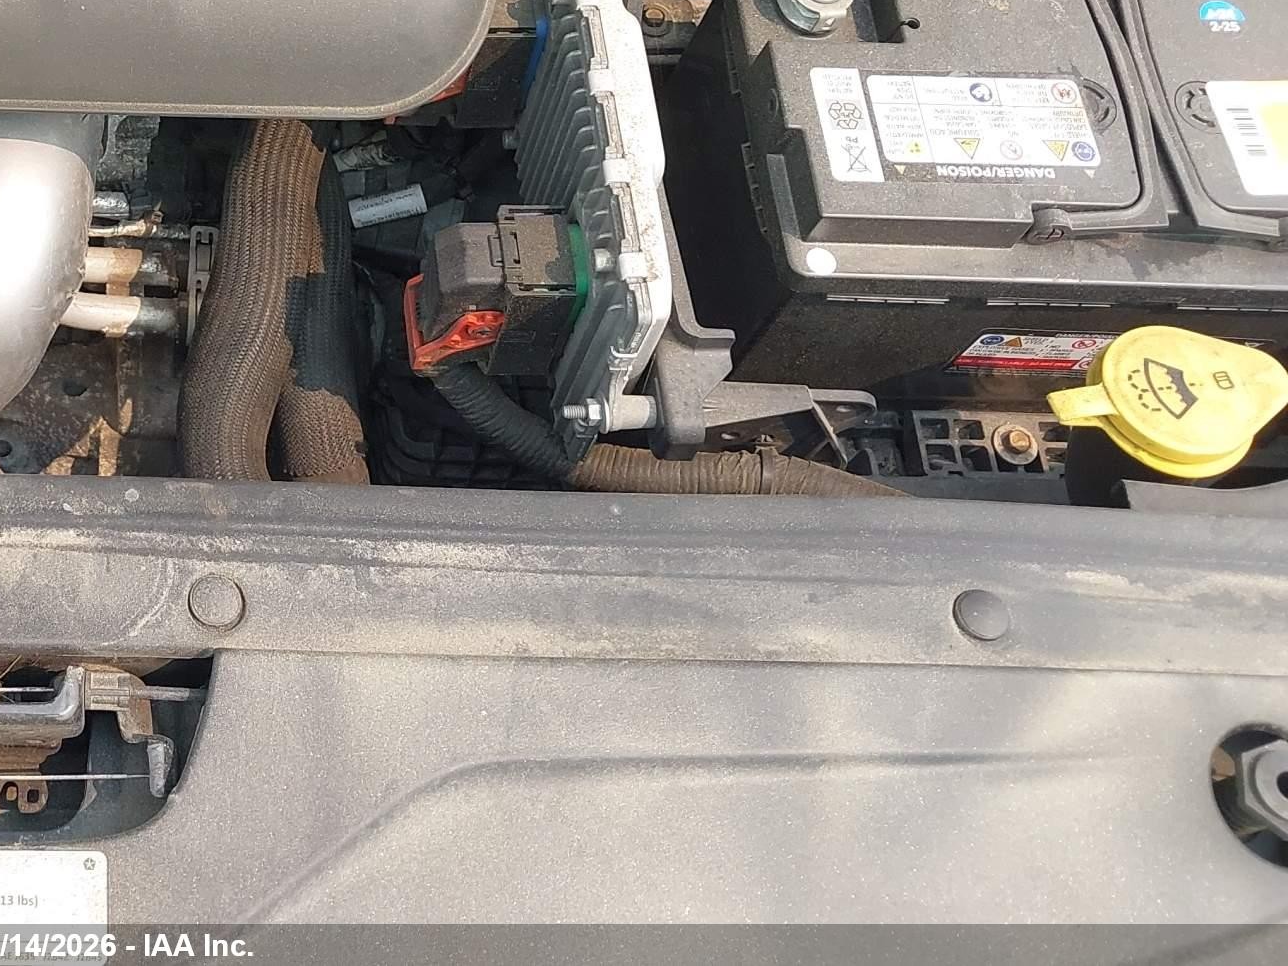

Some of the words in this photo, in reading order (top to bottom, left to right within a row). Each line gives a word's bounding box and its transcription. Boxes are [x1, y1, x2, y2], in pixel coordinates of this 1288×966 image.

[1209, 20, 1241, 33] 2-25
[844, 136, 858, 144] Pb
[935, 165, 1056, 179] DANGER/POISON
[17, 895, 39, 908] lbs)
